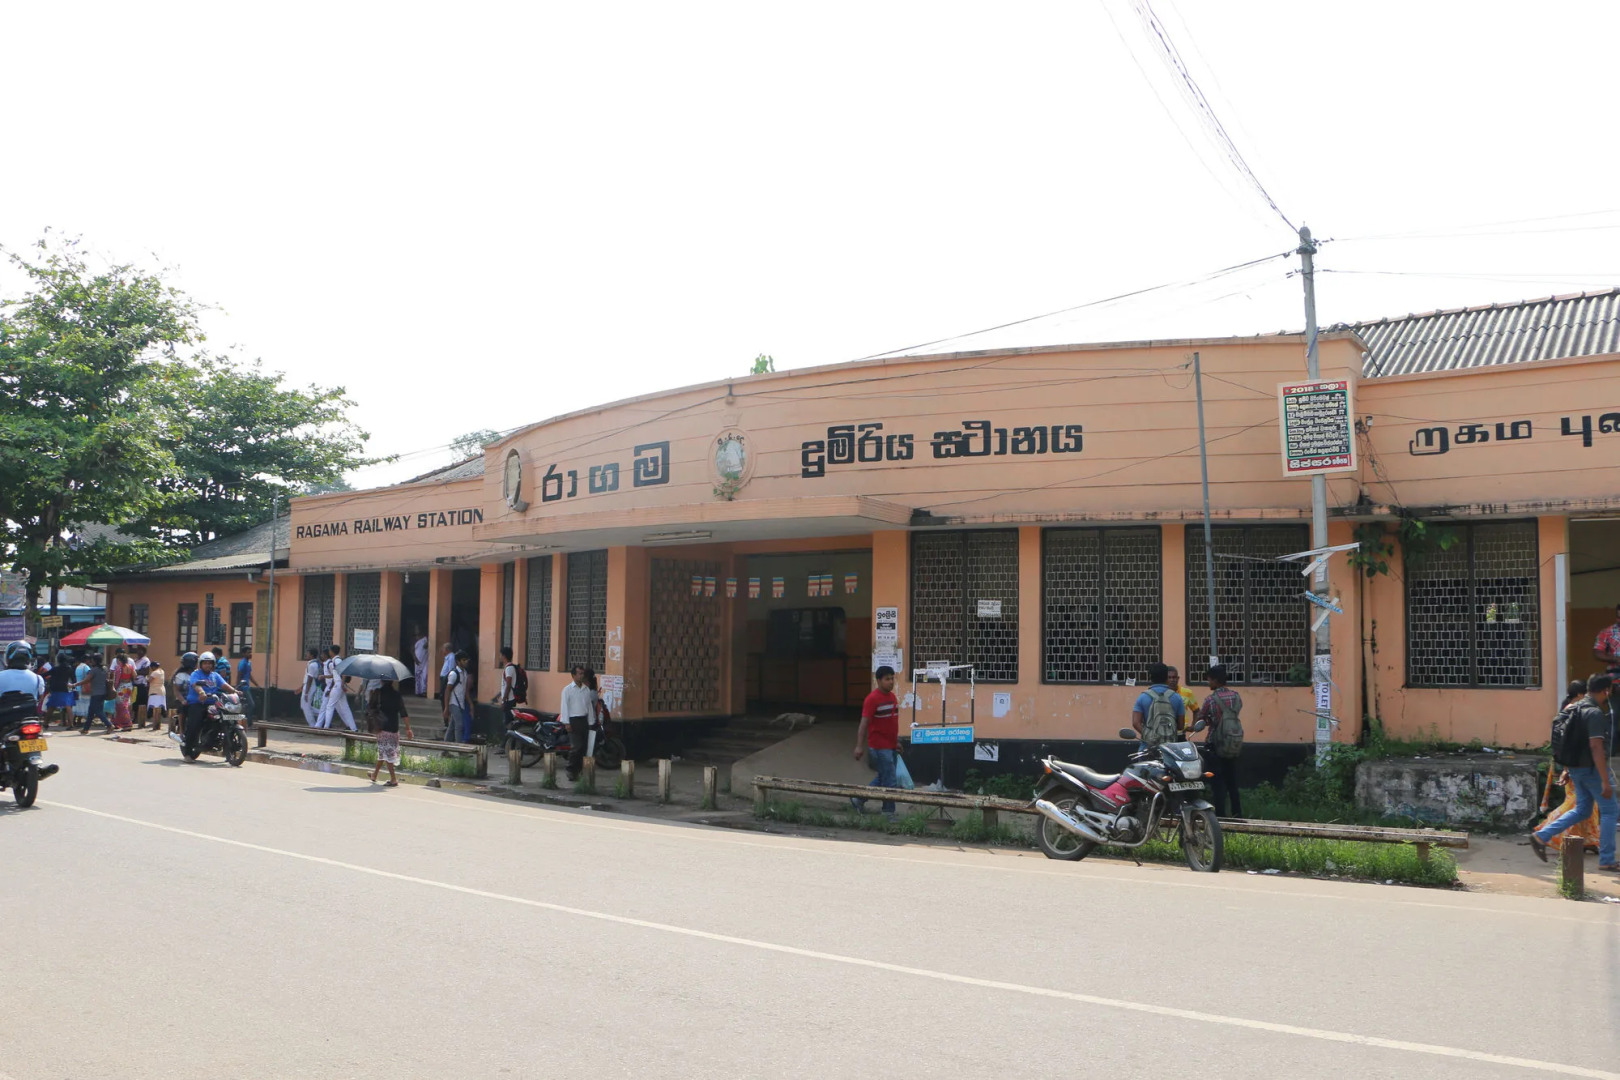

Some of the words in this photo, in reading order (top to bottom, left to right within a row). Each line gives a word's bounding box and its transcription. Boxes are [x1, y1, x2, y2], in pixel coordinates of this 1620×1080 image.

[542, 440, 670, 503] රාගම
[296, 521, 348, 539] RAGAMA
[353, 514, 411, 534] RAILWAY
[417, 507, 484, 529] STATION
[1321, 683, 1329, 693] TO
[1321, 694, 1329, 708] LET
